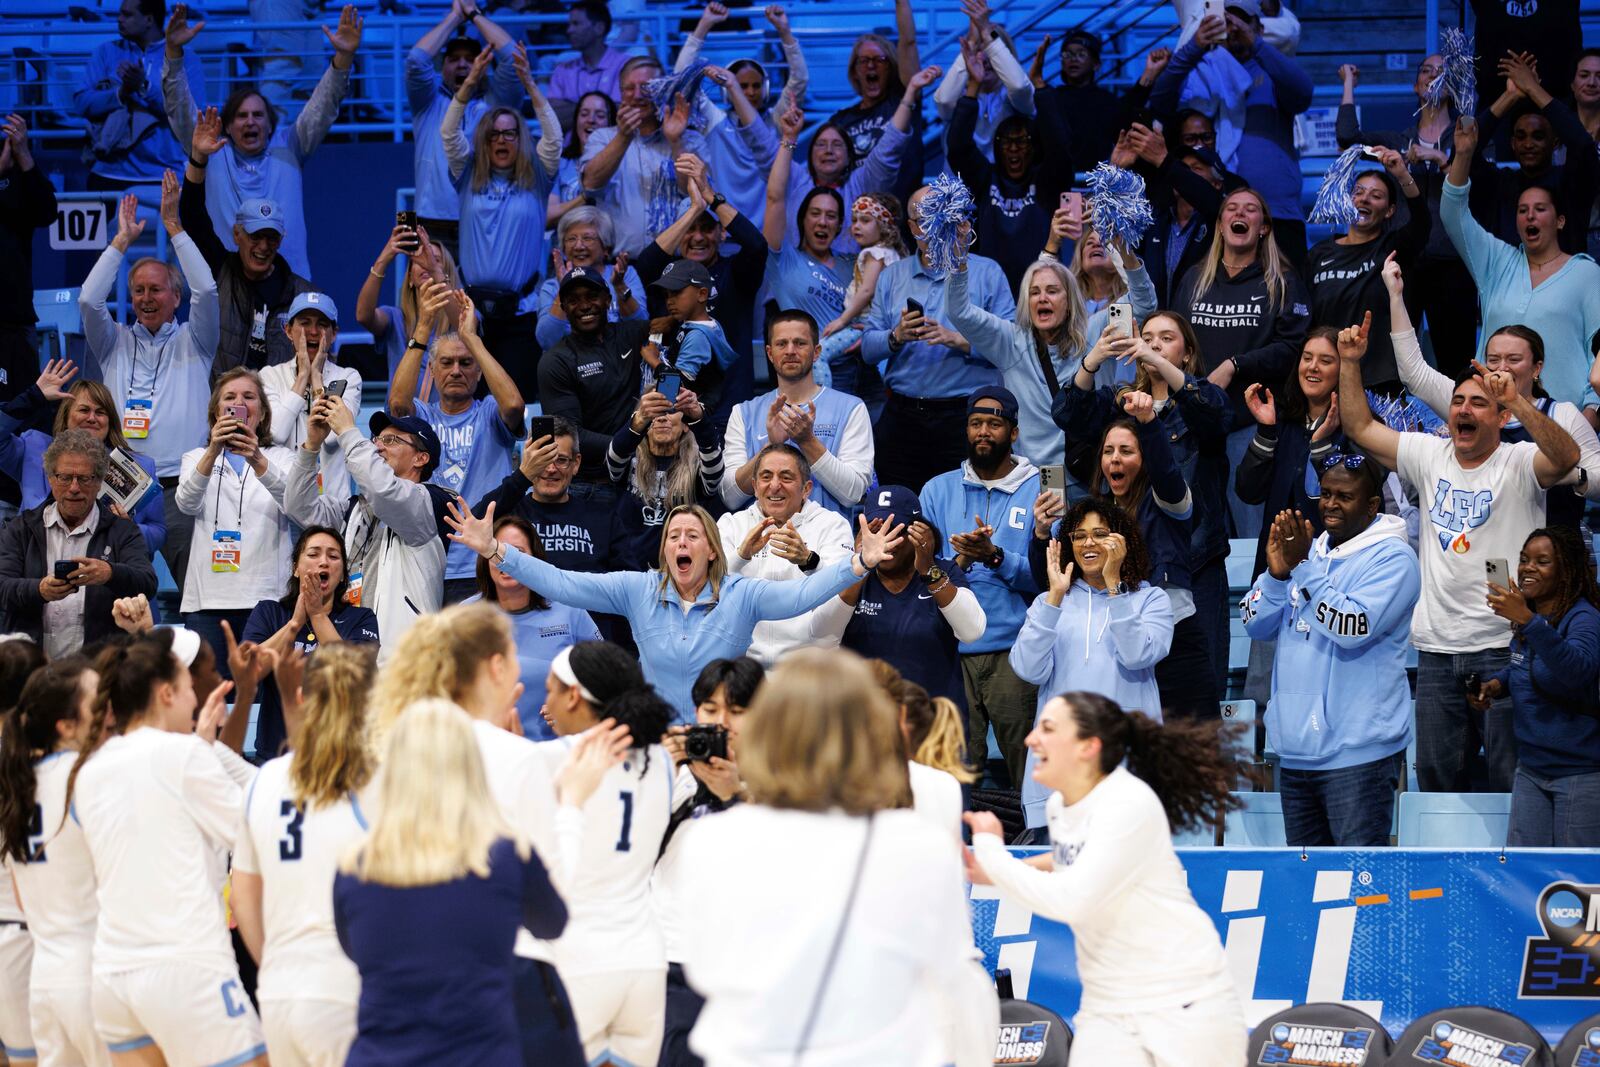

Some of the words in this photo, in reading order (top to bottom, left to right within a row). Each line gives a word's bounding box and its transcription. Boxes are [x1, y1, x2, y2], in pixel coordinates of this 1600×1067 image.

[58, 209, 103, 242] 107
[1313, 259, 1375, 284] COLUMIA
[308, 292, 319, 304] C
[1192, 302, 1261, 315] COLUMBIA
[1191, 316, 1259, 328] BASKETBALL
[878, 491, 892, 507] C
[1009, 506, 1027, 530] C
[532, 523, 592, 541] LUMBIA
[541, 538, 594, 555] ERSITY
[1315, 601, 1370, 636] BULLS
[1224, 704, 1232, 718] 8
[279, 800, 309, 861] 3
[615, 791, 633, 852] 1
[1550, 907, 1583, 919] NCAA
[220, 979, 247, 1019] C
[1288, 1027, 1344, 1047] MARCH
[1446, 1028, 1506, 1057] MARCH
[995, 1041, 1044, 1059] DNESS
[1291, 1043, 1365, 1065] MADNESS
